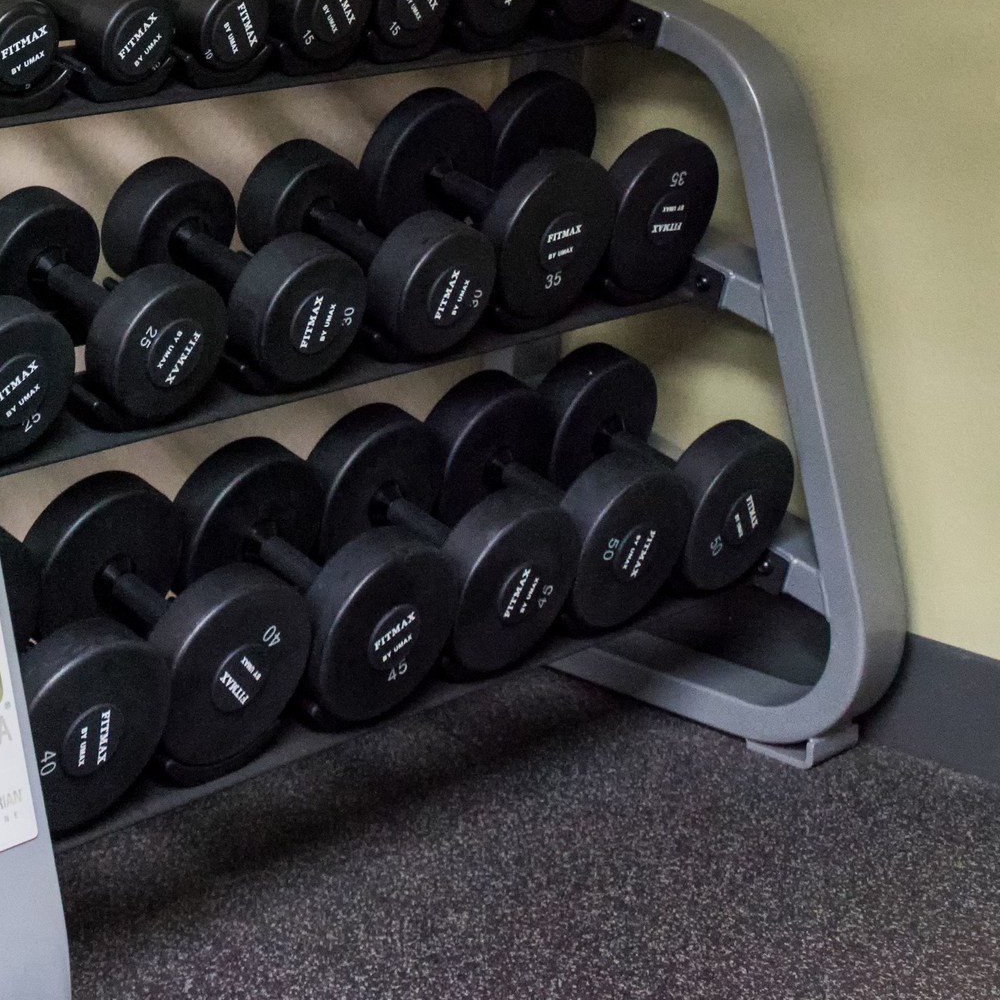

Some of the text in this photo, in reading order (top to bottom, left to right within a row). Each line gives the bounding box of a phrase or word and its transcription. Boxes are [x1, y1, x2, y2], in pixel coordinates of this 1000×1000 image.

[237, 2, 258, 47] FITMAX
[323, 4, 338, 34] BY UMAX
[411, 3, 421, 21] UMAX
[1, 25, 48, 60] FITMAX
[118, 12, 158, 60] FITMAX
[224, 22, 238, 54] BY UMAX
[303, 30, 314, 45] 15
[390, 22, 400, 36] 15
[11, 51, 45, 75] BY UMAX
[134, 33, 162, 67] BY UMAX
[204, 49, 213, 59] 10
[670, 171, 687, 187] 35
[547, 224, 582, 243] FITMAX
[651, 222, 682, 233] FITMAX
[545, 270, 562, 289] 35
[434, 270, 460, 320] FITMAX
[452, 280, 470, 315] BY UMAX
[300, 296, 324, 348] FITMAX
[320, 304, 336, 341] BY UMAX
[342, 307, 354, 326] 30
[140, 326, 157, 348] 25
[157, 331, 182, 368] BY UMAX
[165, 331, 201, 385] FITMAX
[6, 384, 40, 418] BY UMAX
[603, 538, 619, 560] 50
[630, 530, 656, 578] FITMAX
[710, 535, 722, 556] 50
[503, 568, 531, 618] FITMAX
[263, 625, 280, 647] 40
[374, 611, 415, 651] FITMAX
[383, 634, 412, 662] BY UMAX
[388, 656, 407, 681] 45
[220, 671, 249, 705] FITMAX
[81, 727, 88, 739] BY
[97, 709, 111, 765] FITMAX
[41, 751, 56, 776] 40
